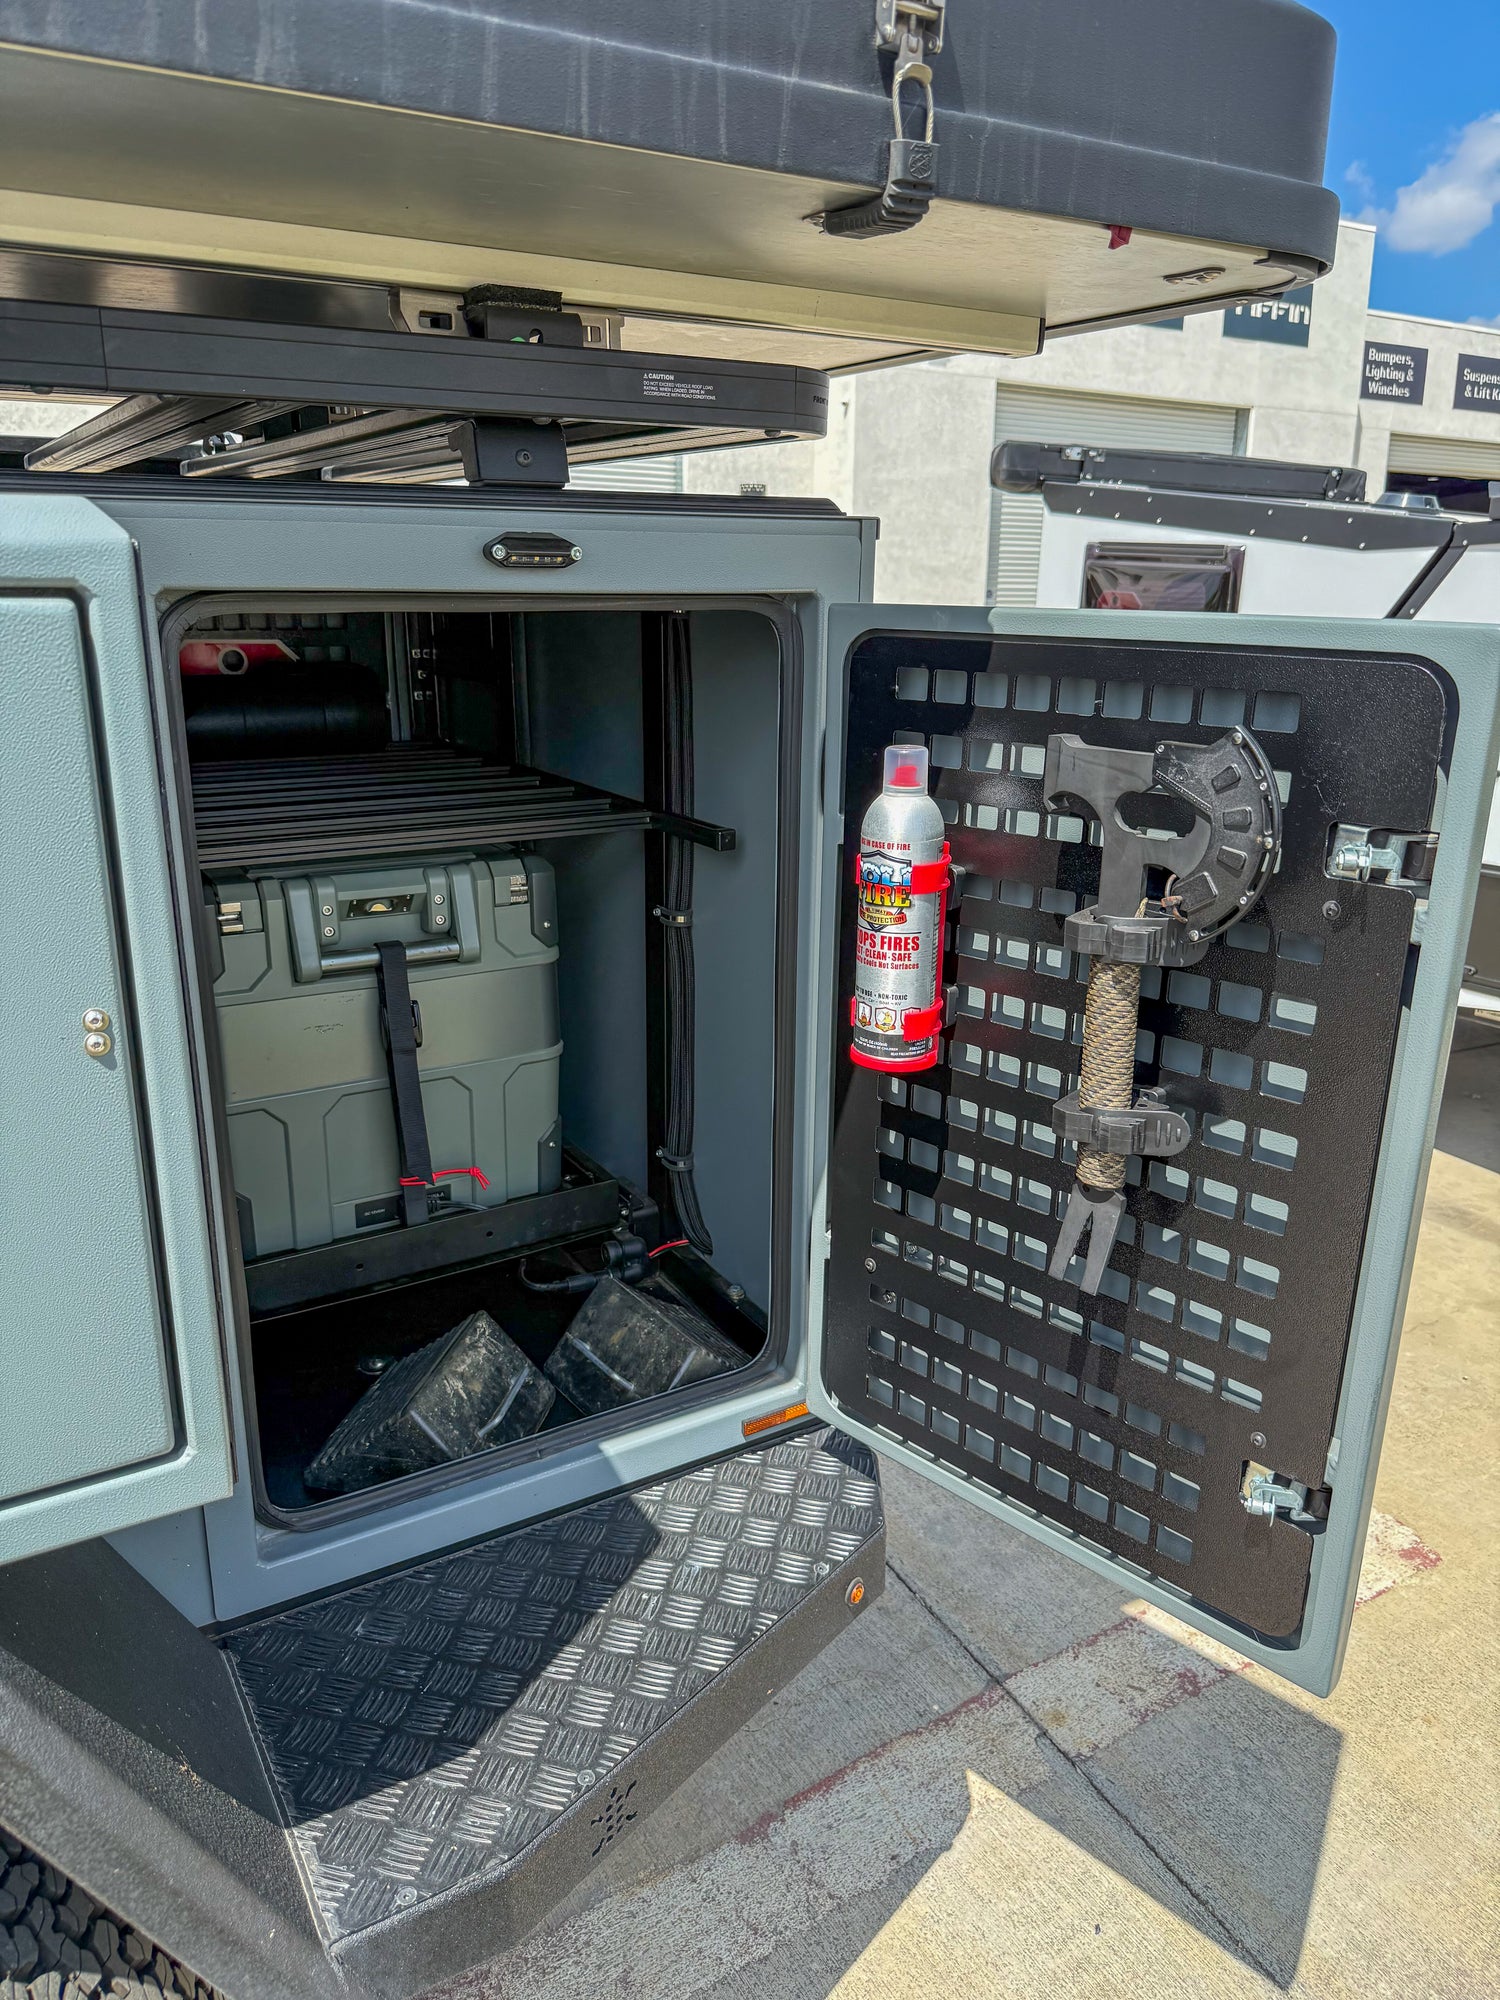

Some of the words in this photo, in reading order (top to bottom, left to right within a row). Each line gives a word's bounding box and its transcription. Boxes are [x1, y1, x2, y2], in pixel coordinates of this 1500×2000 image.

[1368, 347, 1414, 368] Bumpers,
[648, 373, 675, 381] CAUTION
[1365, 364, 1405, 383] Lighting
[1406, 369, 1414, 382] &
[1368, 381, 1411, 398] Winches
[1464, 384, 1472, 398] &
[1473, 385, 1491, 400] Lift
[872, 840, 885, 850] CASE
[886, 842, 895, 850] OF
[896, 843, 911, 851] FIRE
[859, 881, 912, 908] FIRE
[866, 913, 904, 924] PROTECTION
[880, 935, 920, 952] FIRES
[864, 948, 887, 961] CLEAN
[891, 952, 912, 962] SAFE
[890, 962, 920, 970] Surfaces
[877, 993, 908, 1001] NON-TOXIC
